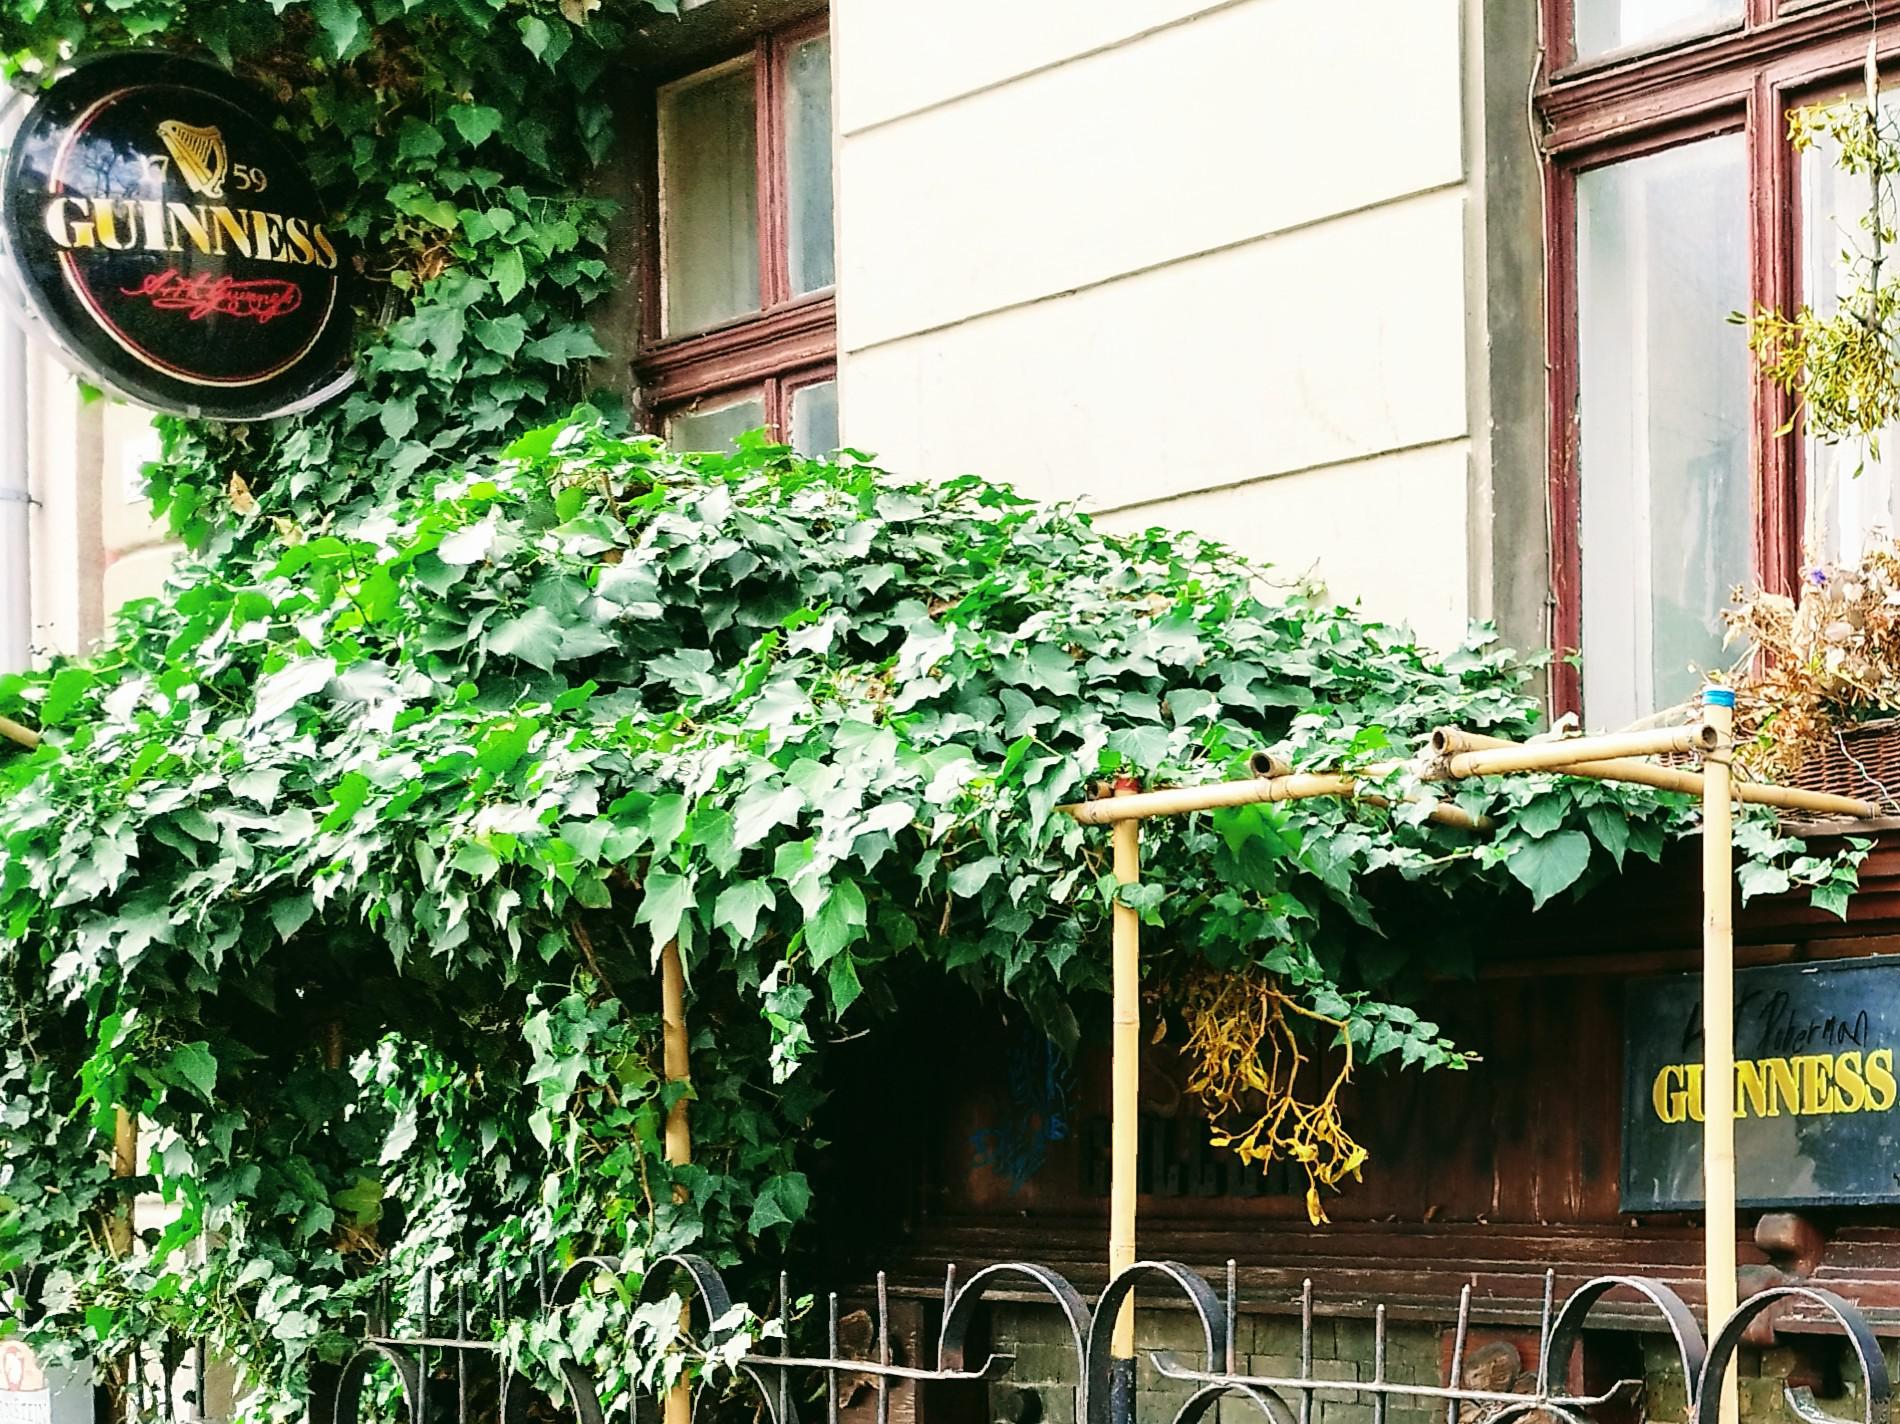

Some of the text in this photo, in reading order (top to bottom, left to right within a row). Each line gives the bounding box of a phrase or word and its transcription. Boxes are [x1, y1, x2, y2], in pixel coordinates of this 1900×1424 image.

[233, 164, 268, 193] 59
[46, 196, 338, 270] GUINNESS
[1651, 1047, 1898, 1124] GUNNESS
